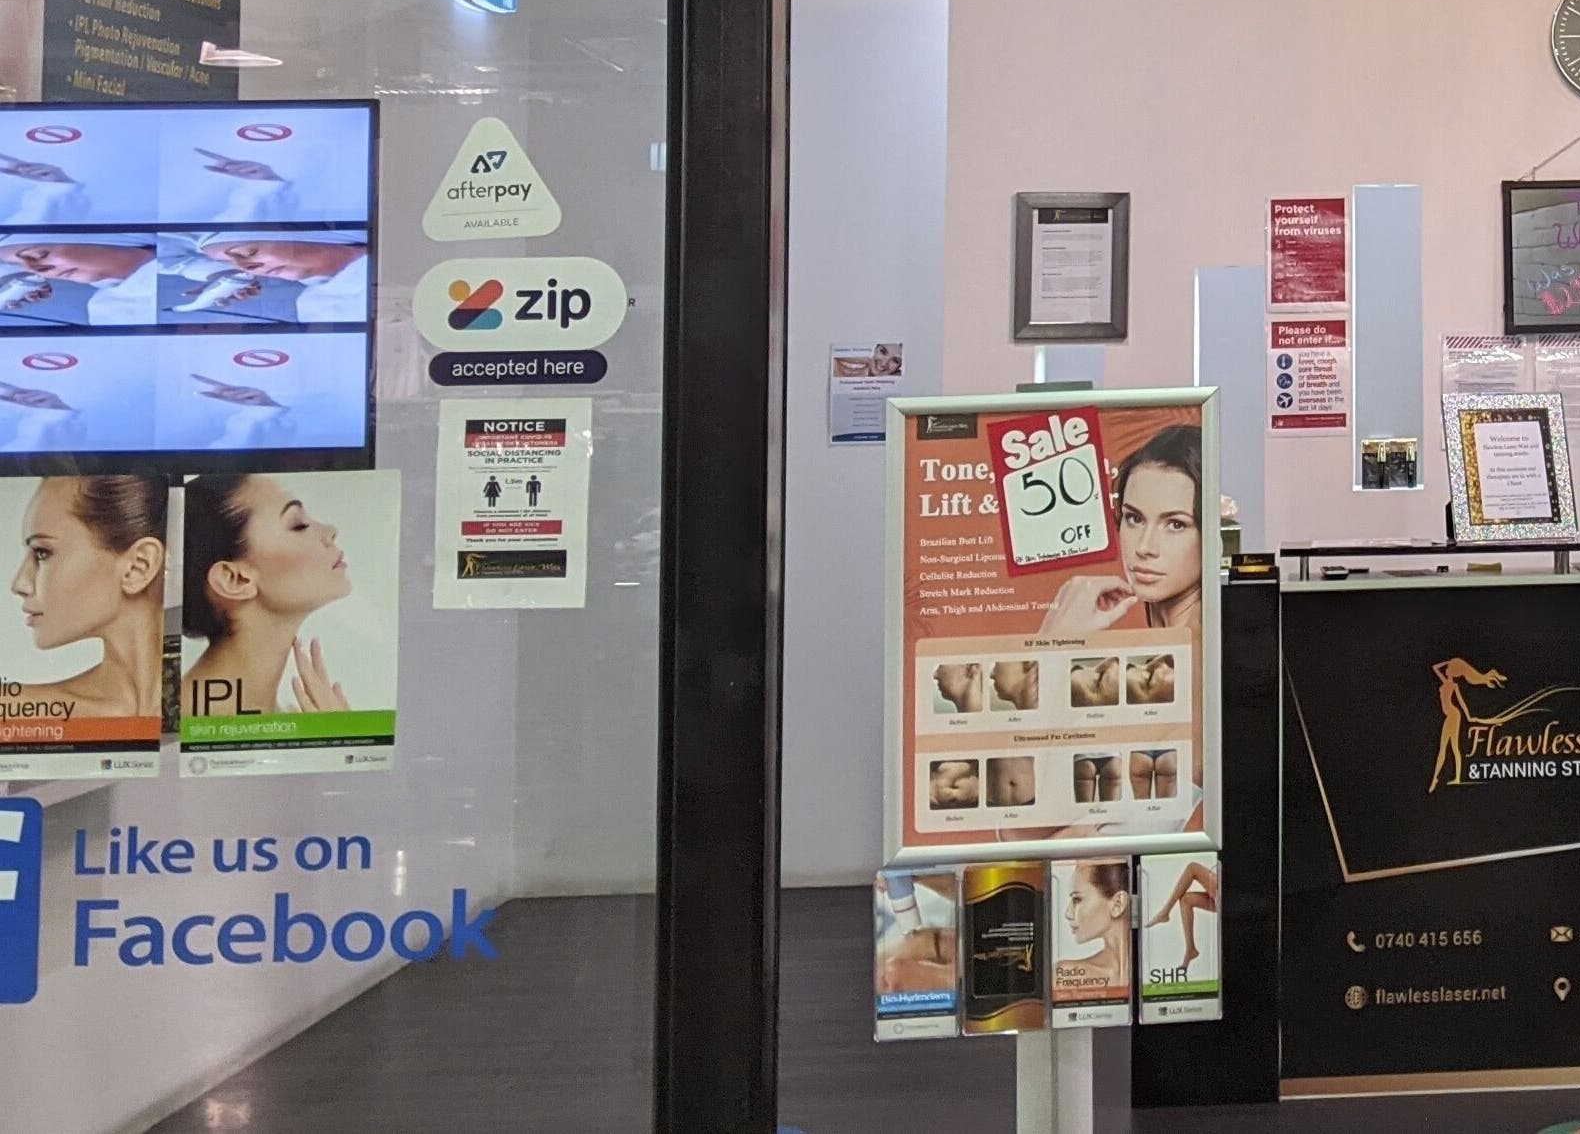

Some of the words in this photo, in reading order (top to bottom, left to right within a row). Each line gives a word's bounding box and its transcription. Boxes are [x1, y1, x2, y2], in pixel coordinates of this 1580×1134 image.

[75, 15, 90, 35] IPL
[92, 20, 121, 43] Photo
[122, 27, 181, 56] Rejuvenation
[75, 39, 139, 70] Pigmentation
[146, 56, 183, 80] Vascular
[190, 66, 211, 86] Acne
[73, 70, 97, 91] Mini
[97, 74, 126, 96] Facial
[447, 181, 532, 202] afterpay
[1275, 204, 1315, 214] Protect
[464, 218, 519, 228] AVAILABLE
[1275, 215, 1318, 226] yourself
[1275, 227, 1300, 236] from
[1304, 226, 1342, 236] viruses
[515, 278, 591, 329] zip
[1279, 326, 1311, 335] Please
[1314, 325, 1327, 334] do
[1279, 337, 1295, 345] not
[1298, 336, 1322, 345] enter
[452, 359, 538, 379] accepted
[543, 359, 585, 376] here
[483, 421, 546, 433] NOTICE
[1002, 415, 1090, 470] Sale
[505, 449, 561, 457] DISTANCING
[485, 457, 495, 465] IN
[498, 456, 544, 464] PRACTICE
[920, 459, 995, 482] Tone,
[1020, 457, 1095, 517] 50
[919, 494, 971, 517] Lift
[978, 496, 999, 515] &
[920, 537, 957, 547] Brazilian
[959, 537, 976, 546] Butt
[978, 535, 993, 545] Lift
[1061, 524, 1091, 544] OFF
[920, 554, 974, 564] Non-Surgical
[920, 571, 953, 581] Cellulite
[956, 570, 997, 579] Reduction
[919, 589, 948, 598] Stretch
[950, 588, 971, 596] Mark
[974, 586, 1015, 596] Reduction
[943, 605, 966, 616] Thigh
[968, 605, 983, 613] and
[984, 603, 1029, 613] Abdominal
[1036, 639, 1050, 647] Skin
[1052, 638, 1085, 647] Tightening
[192, 678, 261, 717] IPL
[189, 723, 216, 737] skin
[219, 722, 297, 738] rejuvenation
[1013, 734, 1049, 743] Ultrasound
[1063, 732, 1096, 741] Cavitation
[74, 827, 196, 876] Like
[212, 840, 279, 873] us
[294, 834, 372, 871] on
[73, 888, 501, 967] Facebook
[1375, 931, 1414, 948] 0740
[1417, 930, 1450, 947] 415
[1452, 929, 1482, 946] 656
[1056, 967, 1086, 978] Radio
[1150, 966, 1188, 985] SHR
[1056, 976, 1111, 988] Frequency
[1375, 984, 1507, 1006] flawlesslaser.net
